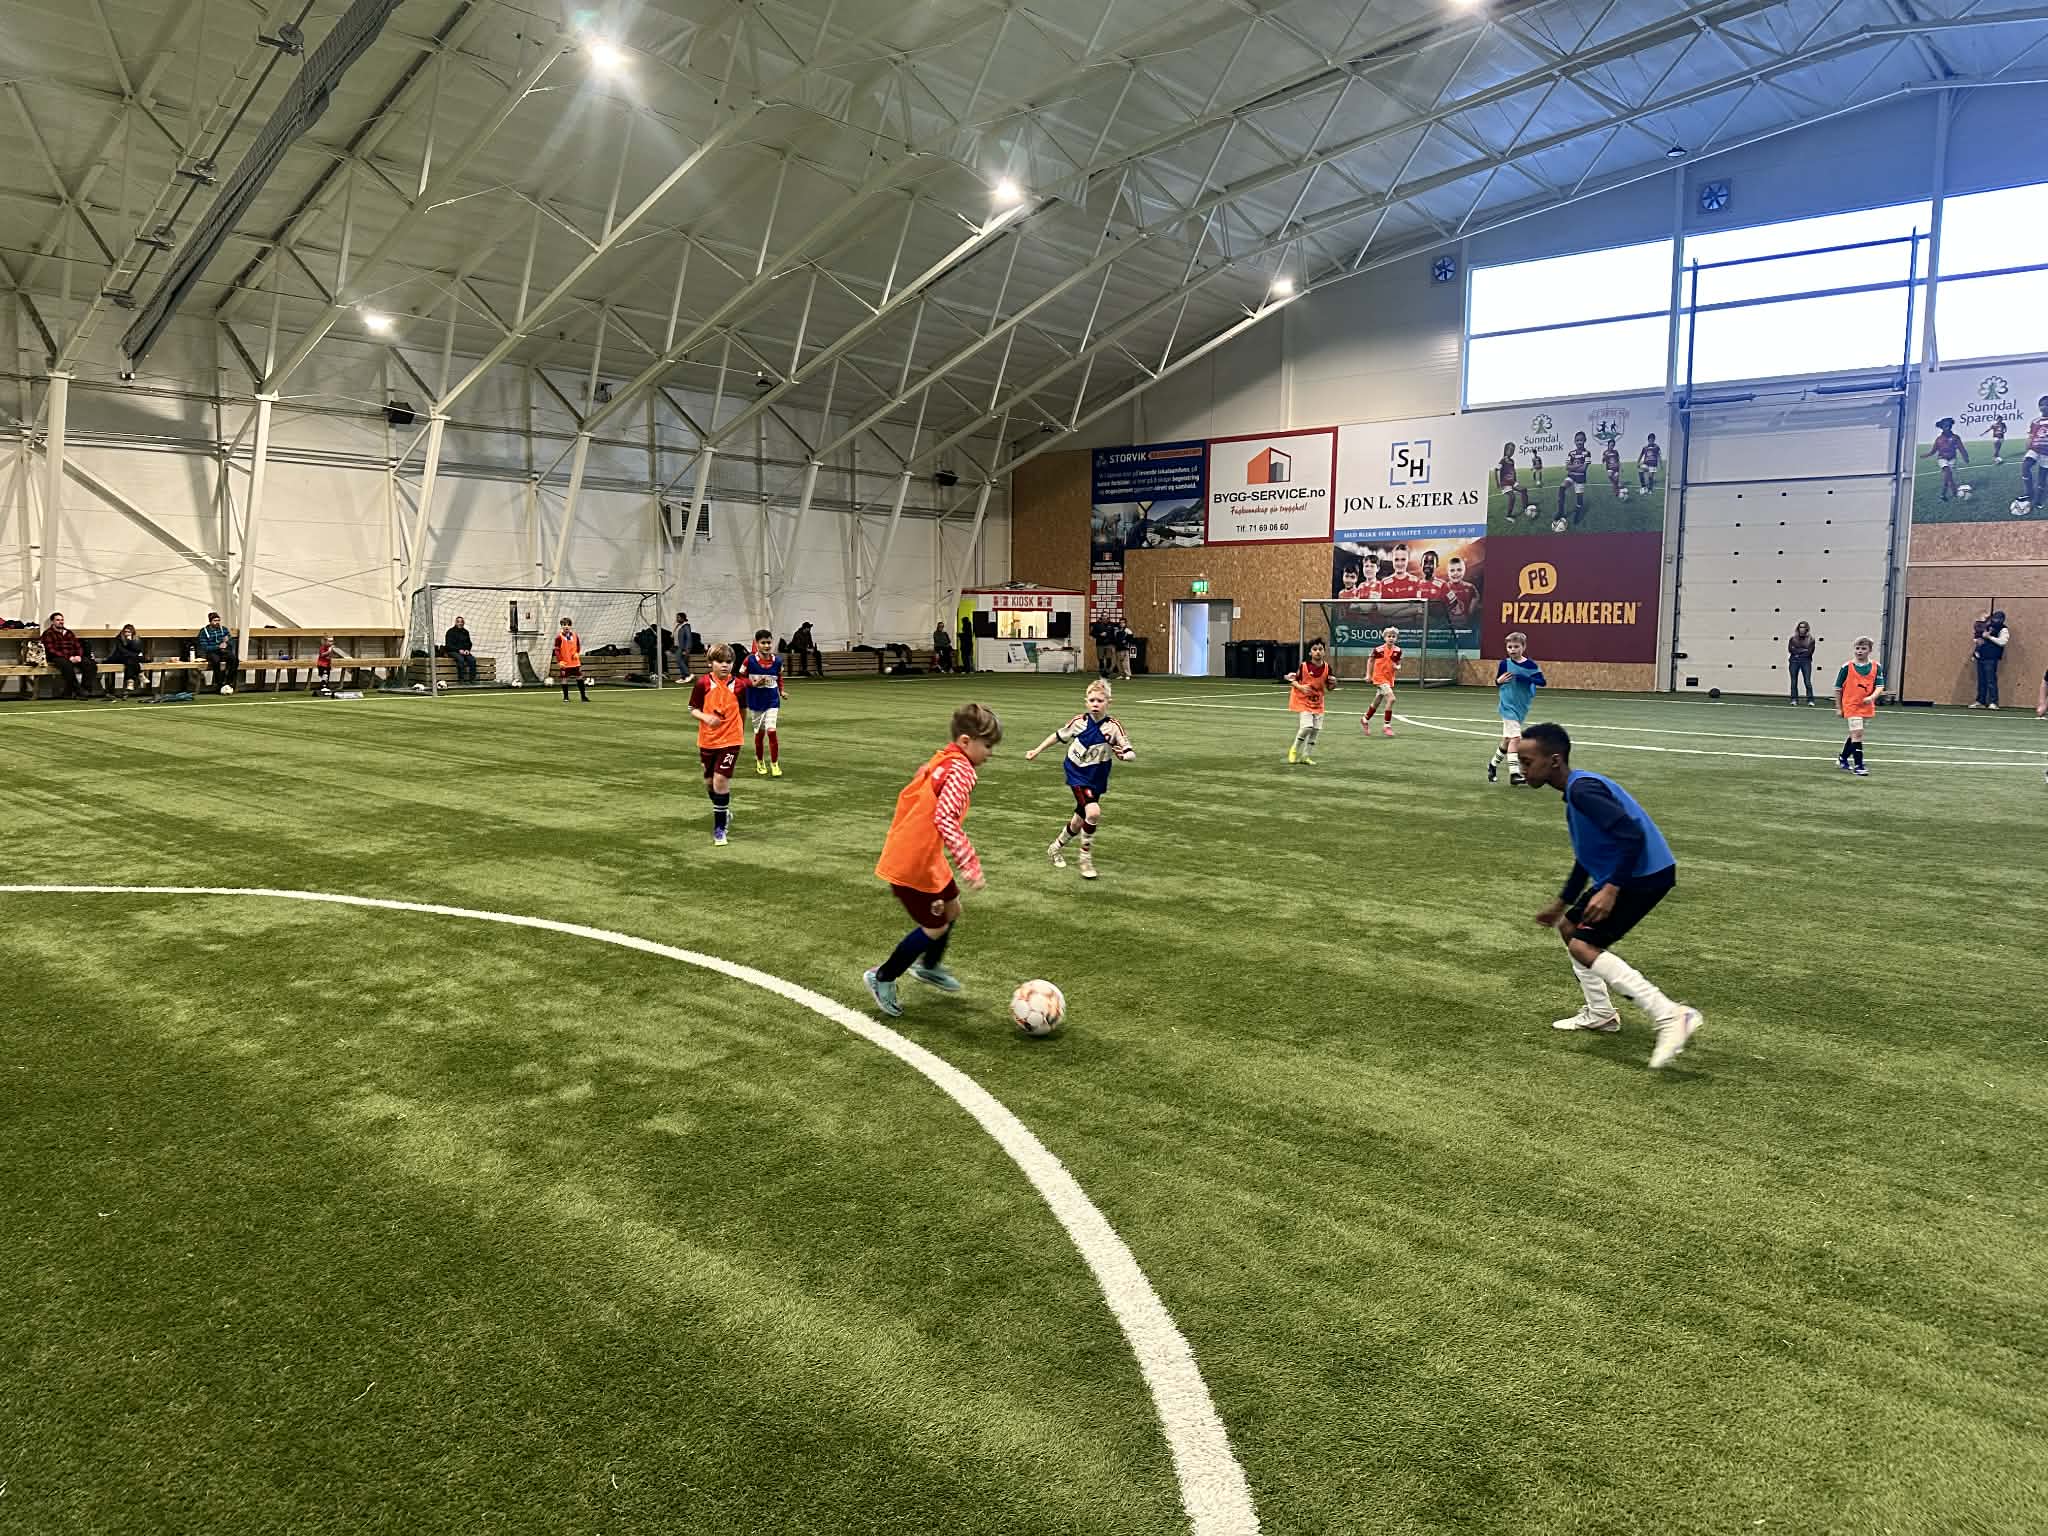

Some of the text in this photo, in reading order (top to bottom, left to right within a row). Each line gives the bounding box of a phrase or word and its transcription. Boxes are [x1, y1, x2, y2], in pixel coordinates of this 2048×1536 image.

[1967, 399, 2016, 412] Sunndal
[1960, 409, 2024, 426] Sparebank
[1523, 432, 1559, 445] Sunndal
[1109, 451, 1147, 464] STORVIK
[1213, 488, 1326, 504] BYGG-SERVICE.no
[1343, 490, 1479, 514] JON L. SÆTER AS
[1249, 524, 1257, 532] 71
[1280, 523, 1289, 531] 60
[1528, 567, 1549, 590] PB
[1011, 596, 1034, 607] KIOSK
[1501, 601, 1637, 625] PIZZABAKEREN
